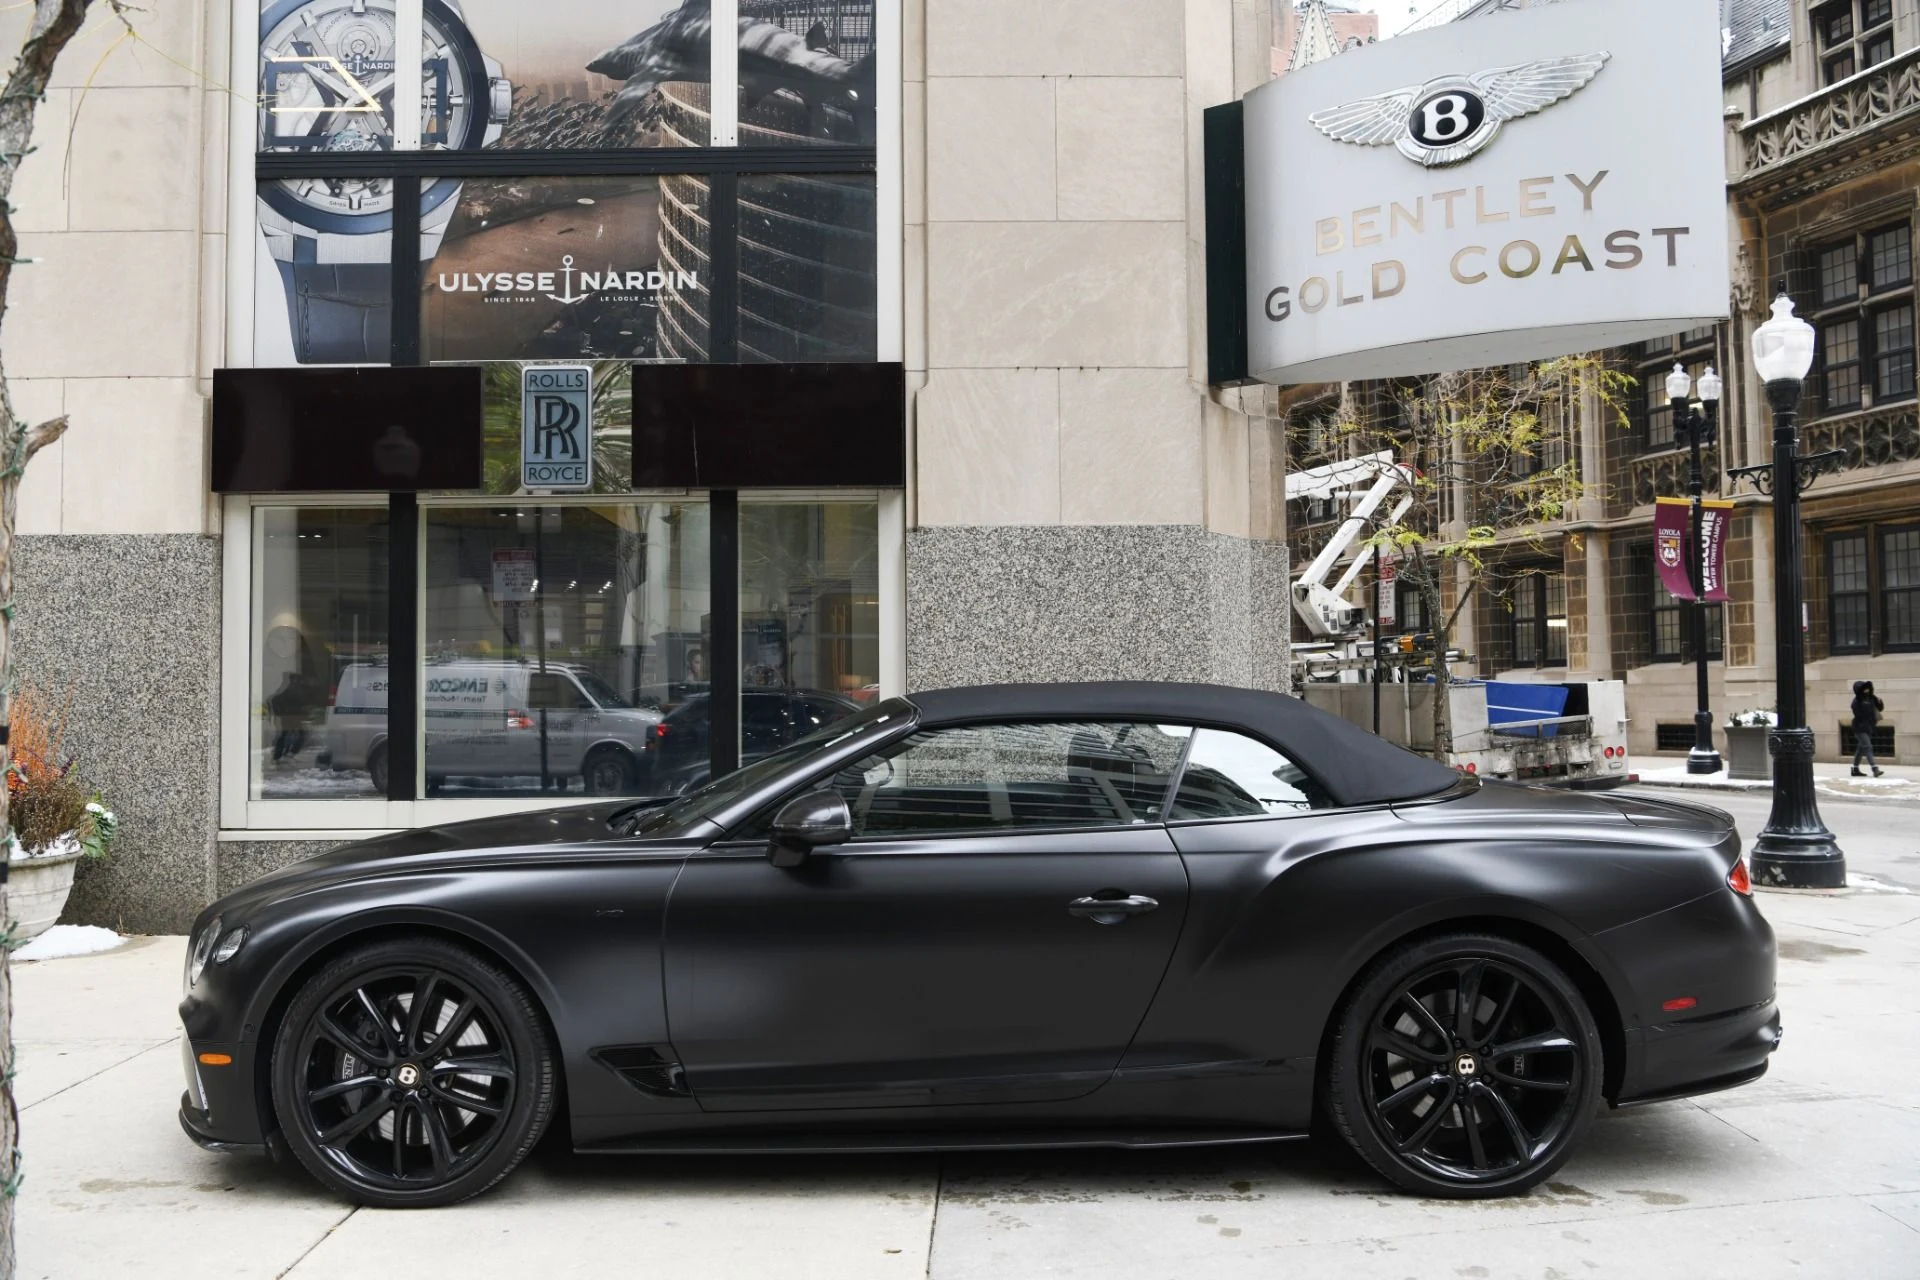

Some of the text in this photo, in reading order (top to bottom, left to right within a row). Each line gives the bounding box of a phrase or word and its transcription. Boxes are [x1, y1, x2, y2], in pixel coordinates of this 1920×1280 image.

[1422, 94, 1470, 141] B
[1315, 169, 1609, 257] BENTLEY
[439, 271, 697, 291] ULYSSE NARDIN
[1264, 226, 1690, 323] GOLD COAST
[529, 374, 584, 388] ROLLS
[528, 467, 583, 481] ROYCE
[1658, 528, 1680, 536] LOYOLA
[1712, 516, 1723, 543] CAMPUS
[1701, 511, 1716, 592] WELCOME
[1710, 543, 1718, 566] TOWER
